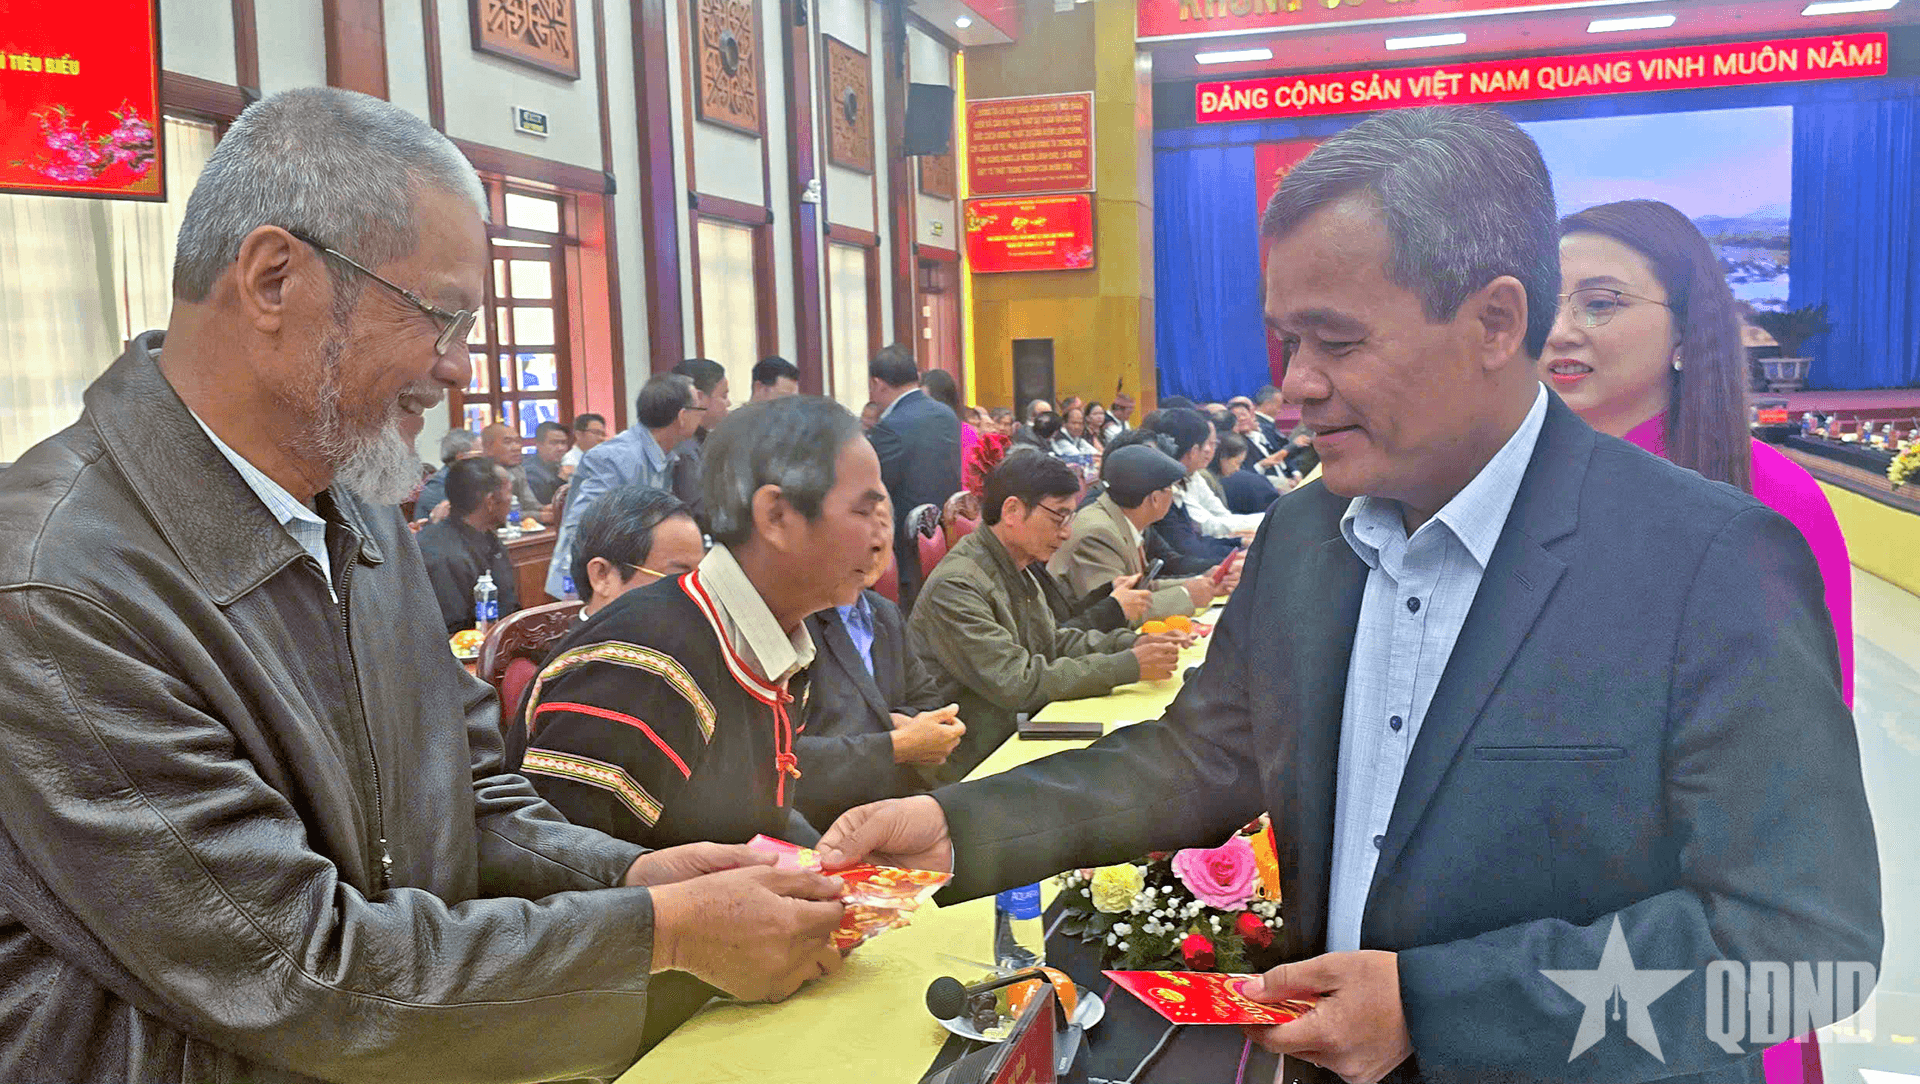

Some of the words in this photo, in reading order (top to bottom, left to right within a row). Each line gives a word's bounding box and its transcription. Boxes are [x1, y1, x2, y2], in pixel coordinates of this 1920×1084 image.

[1201, 84, 1269, 113] ĐẢNG
[1275, 80, 1344, 110] CỘNG
[1350, 73, 1401, 102] SẢN
[1407, 70, 1464, 100] VIỆT
[1470, 68, 1529, 94] NAM
[1537, 60, 1632, 91] QUANG
[1637, 55, 1705, 82] VINH
[1713, 45, 1798, 76] MUÔN
[1807, 40, 1882, 69] NĂM!
